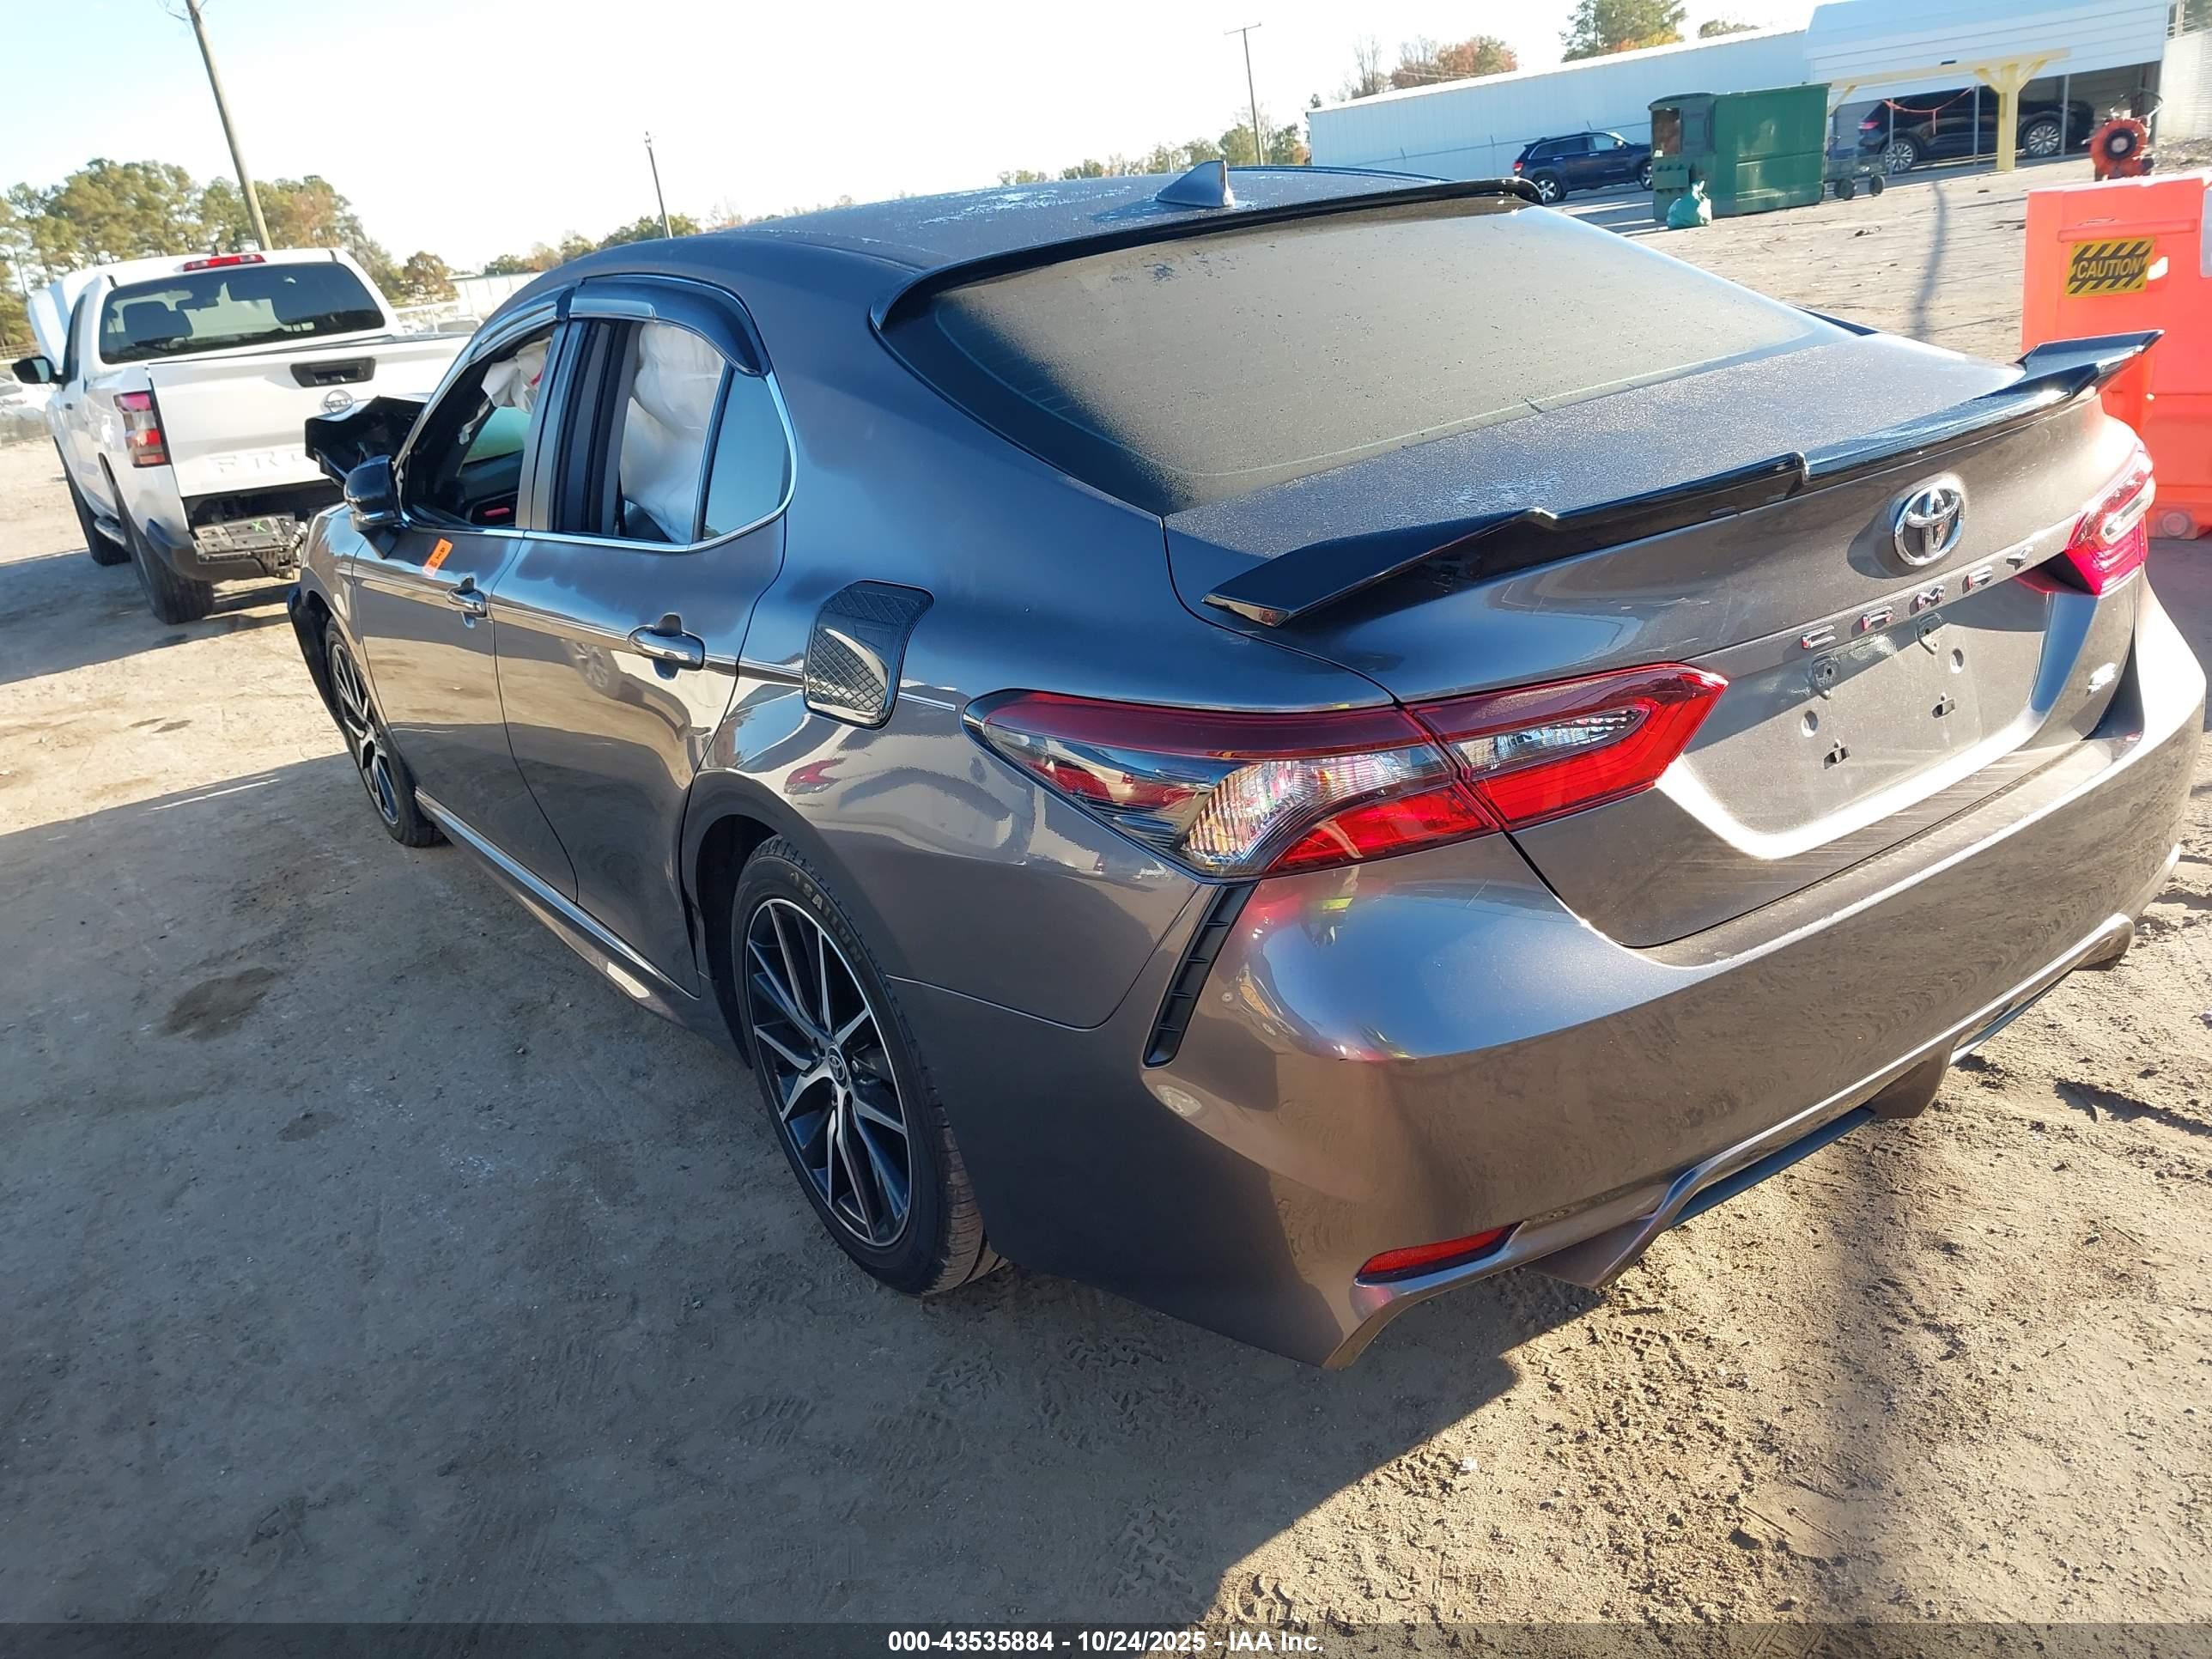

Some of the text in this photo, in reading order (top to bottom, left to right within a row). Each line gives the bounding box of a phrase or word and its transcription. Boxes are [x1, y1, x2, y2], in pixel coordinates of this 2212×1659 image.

[2075, 257, 2141, 279] CAUTION
[1802, 545, 2034, 650] CAMRY
[802, 883, 863, 963] SAILUN
